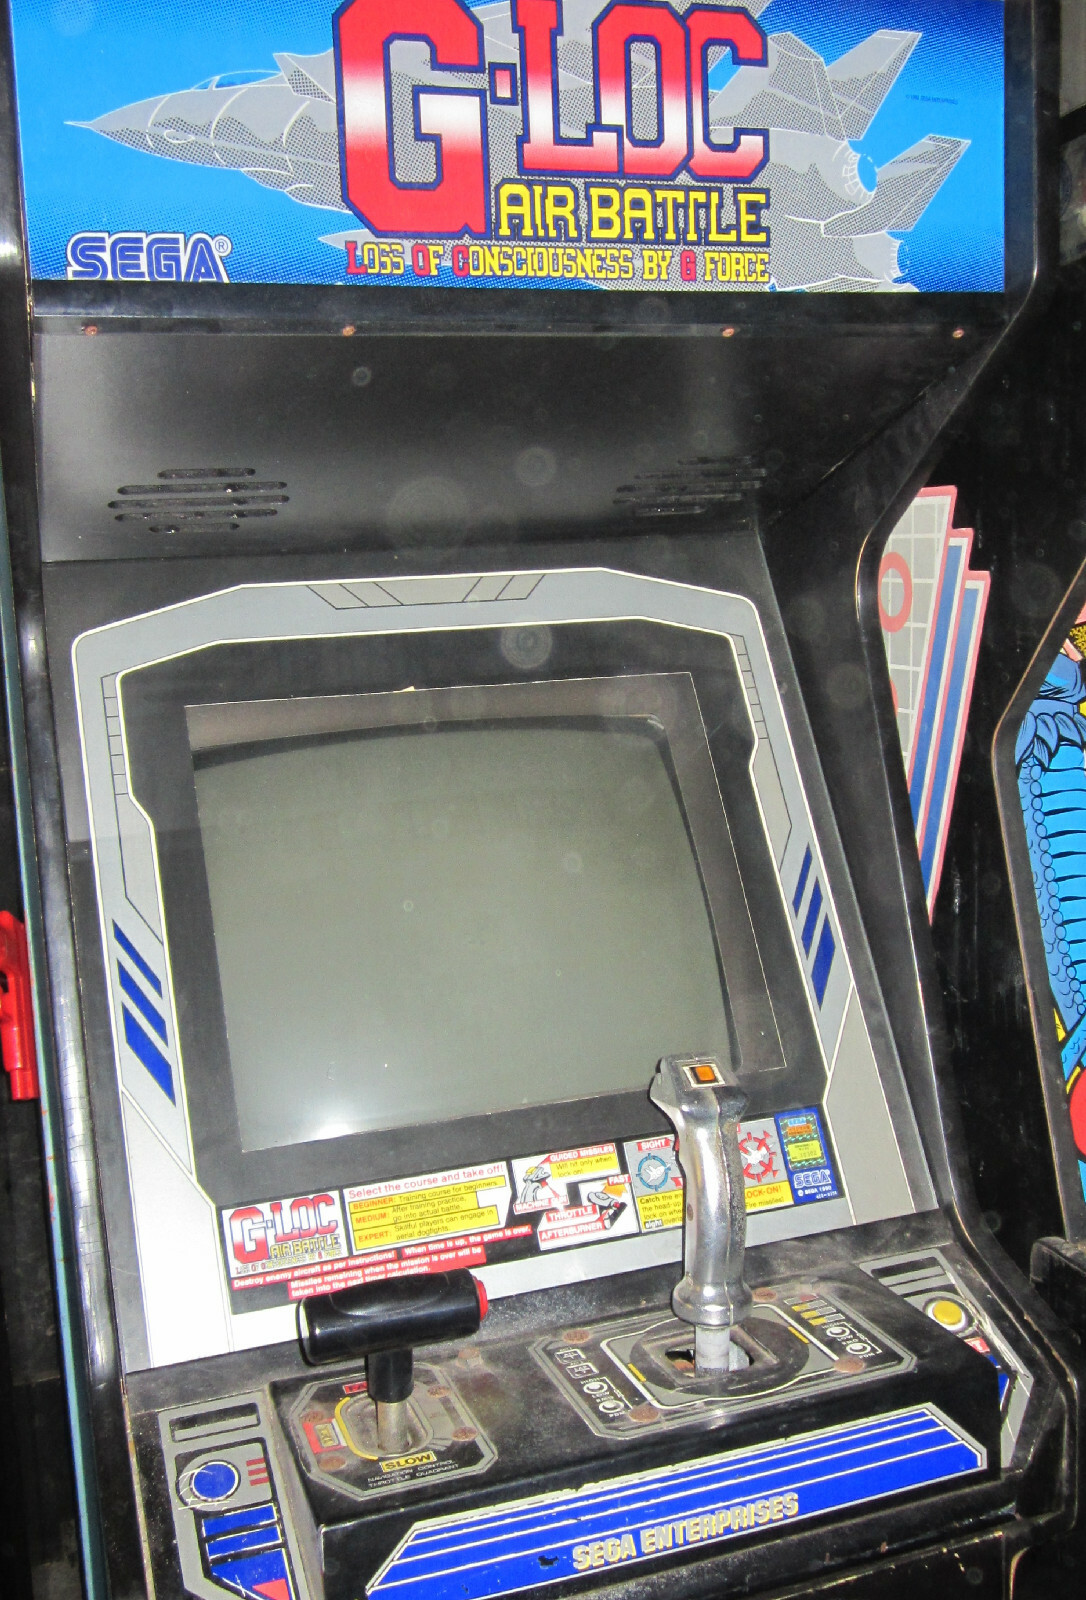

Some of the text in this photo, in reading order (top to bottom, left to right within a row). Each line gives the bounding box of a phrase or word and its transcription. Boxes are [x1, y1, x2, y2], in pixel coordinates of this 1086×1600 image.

[495, 178, 771, 246] AIR BATTLE
[345, 241, 770, 284] LOSS OF CONSCIOUSNESS BY G FORCE
[641, 1139, 666, 1151] SIGHT
[549, 1149, 578, 1161] GUIDED
[348, 1164, 504, 1200] Select the course and take off!
[608, 1175, 629, 1186] FAST
[353, 1197, 396, 1211] BEGINNER:
[399, 1193, 427, 1203] Training
[428, 1189, 451, 1198] course
[640, 1195, 660, 1205] Catch
[662, 1193, 673, 1202] the
[745, 1185, 782, 1199] OCK-ON!
[392, 1205, 408, 1214] After
[410, 1200, 436, 1211] training
[393, 1216, 402, 1224] go
[404, 1212, 416, 1220] into
[419, 1207, 440, 1217] actual
[548, 1205, 593, 1221] THROTTLE
[642, 1205, 653, 1213] the
[669, 1208, 683, 1217] whe
[419, 1217, 444, 1229] players
[446, 1215, 459, 1223] can
[460, 1210, 485, 1222] engage
[487, 1208, 494, 1216] in
[645, 1219, 663, 1230] sight
[541, 1221, 603, 1240] AFTERBURNER
[270, 1233, 341, 1259] AIR BATTLE
[404, 1226, 531, 1256] When time is up, the game is over.
[233, 1275, 264, 1289] Destroy
[265, 1271, 292, 1282] enemy
[293, 1265, 321, 1277] aircraft
[323, 1263, 332, 1271] as
[333, 1261, 347, 1271] per
[348, 1251, 395, 1267] instructions!
[290, 1245, 482, 1289] Missiles remaining when the mission is over will be
[291, 1286, 314, 1297] taken
[315, 1283, 331, 1293] into
[333, 1280, 346, 1289] the
[385, 1453, 432, 1470] SLOW
[572, 1492, 799, 1570] SEGA ENTERPRISES
